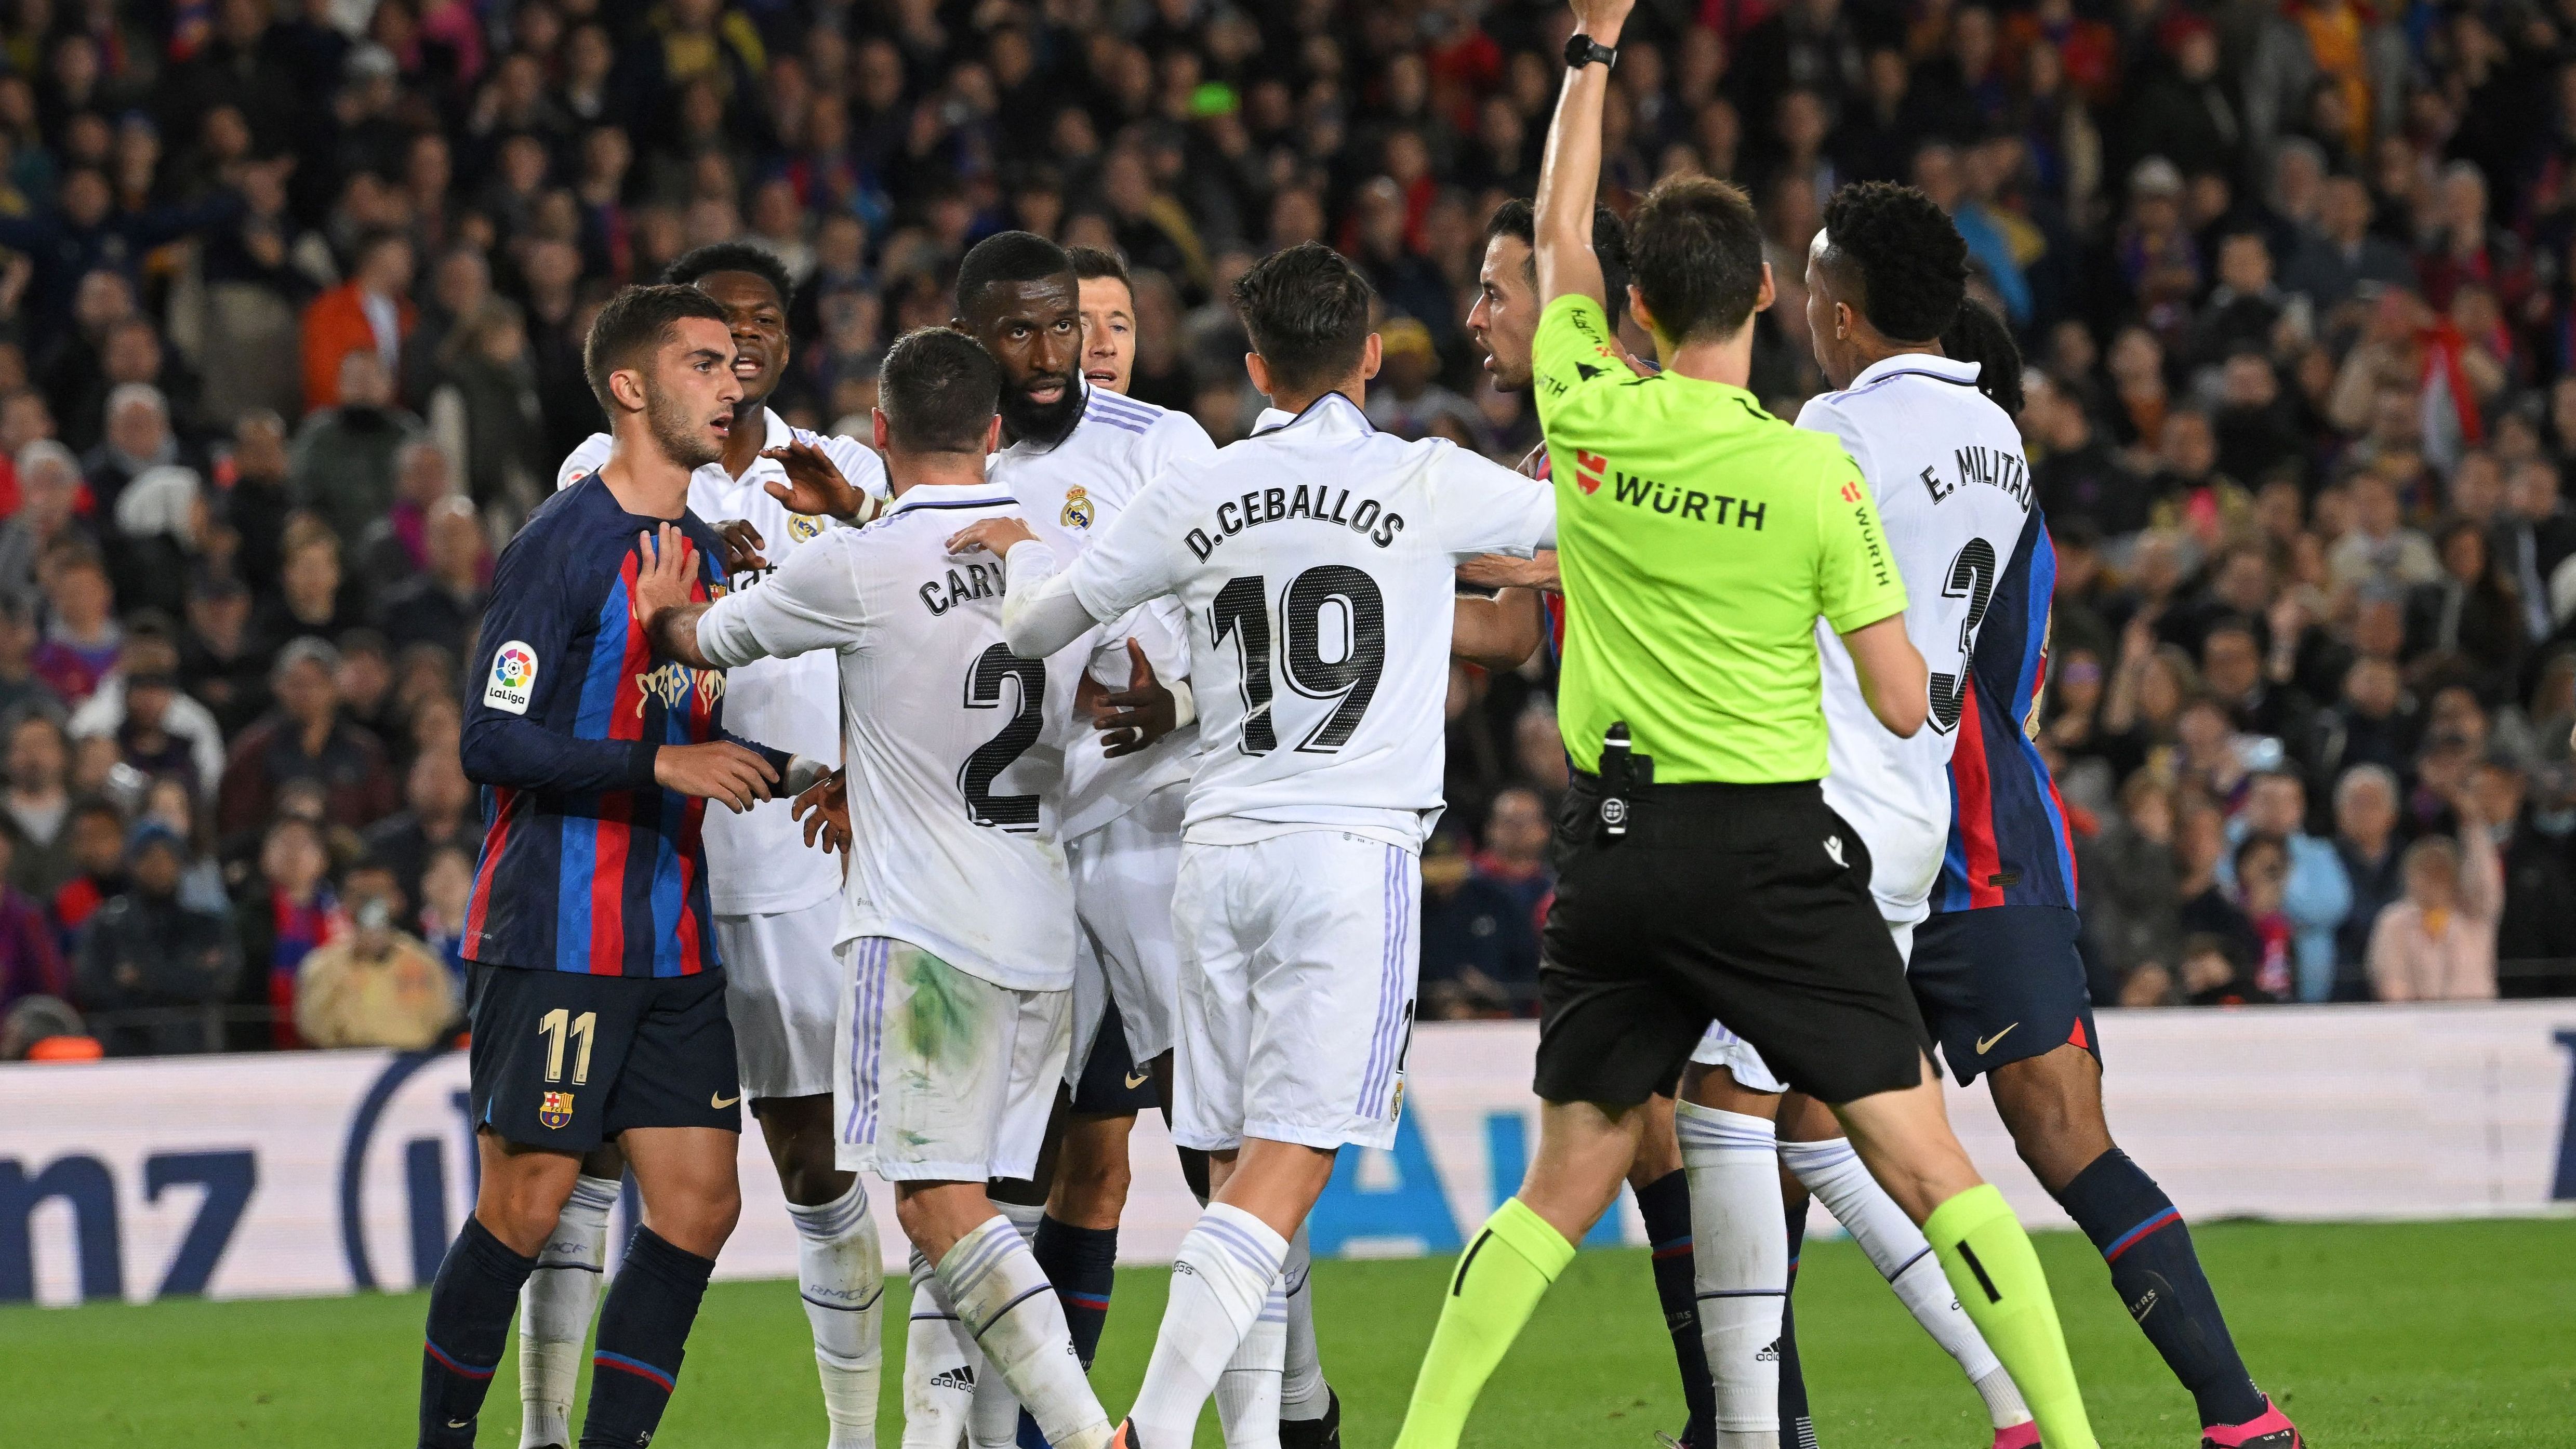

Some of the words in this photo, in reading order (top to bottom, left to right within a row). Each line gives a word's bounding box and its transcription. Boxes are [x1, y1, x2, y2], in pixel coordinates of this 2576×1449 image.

[1920, 464, 1954, 506] E.
[1184, 485, 1404, 564] D.CEBALLOS
[1206, 565, 1385, 758] 19
[1926, 537, 1996, 737] 3
[489, 687, 525, 704] LaLiga
[957, 642, 1046, 833] 2
[539, 1008, 596, 1086] 11
[931, 1377, 976, 1395] adidas
